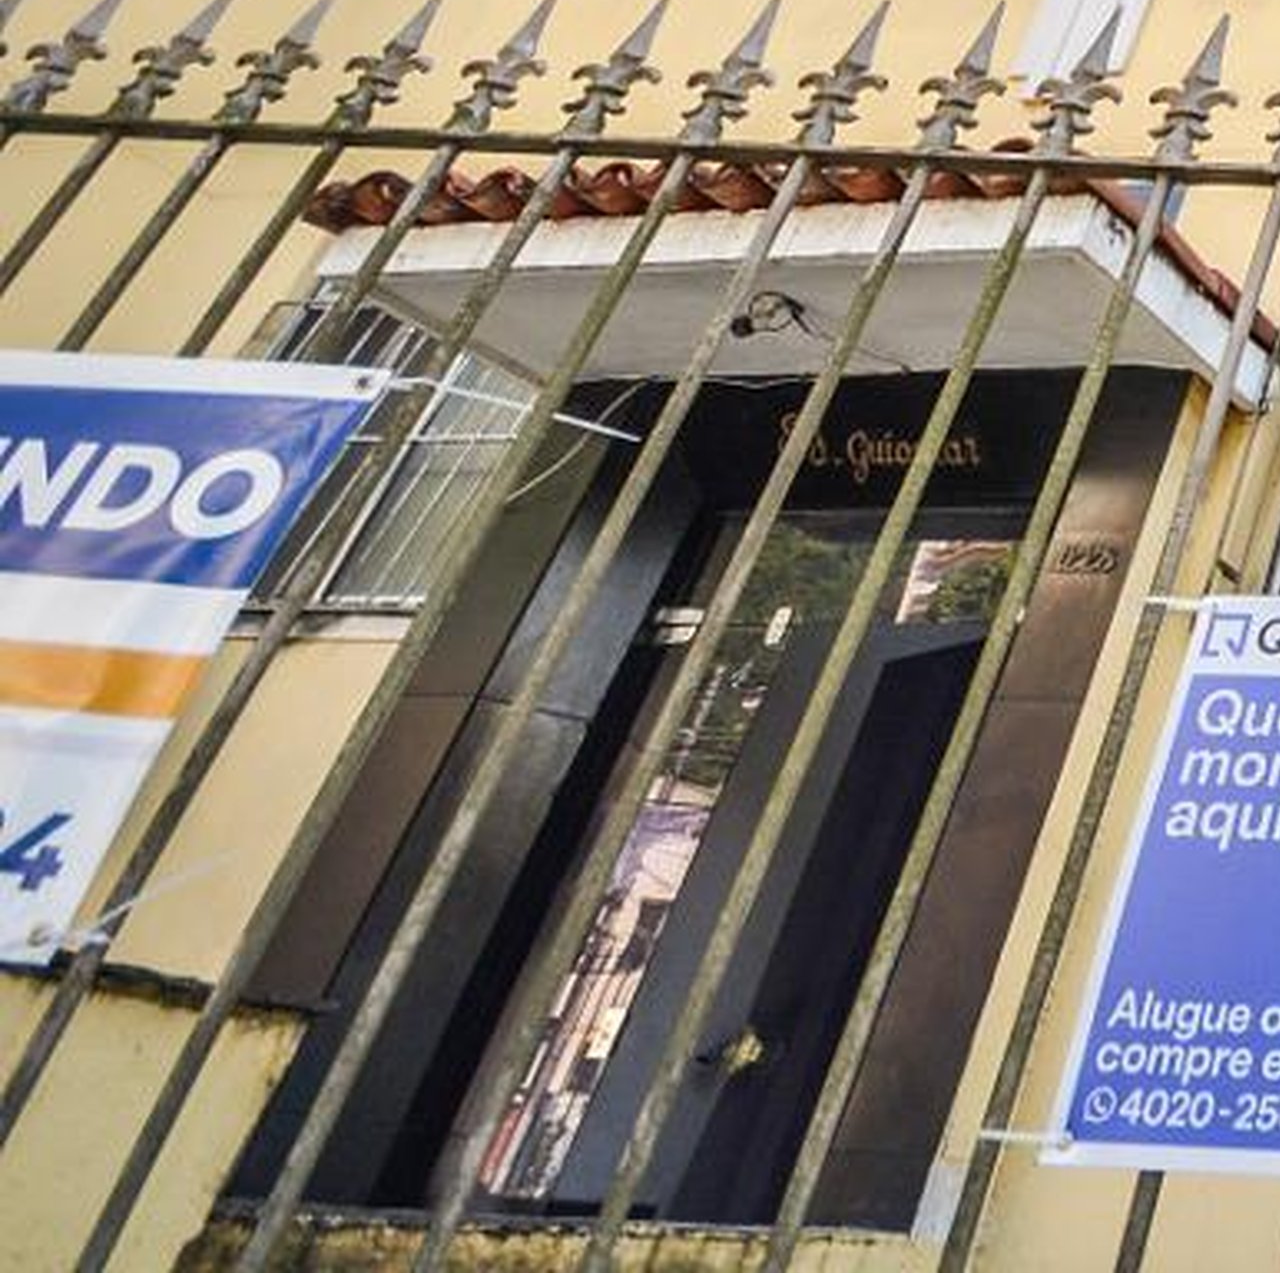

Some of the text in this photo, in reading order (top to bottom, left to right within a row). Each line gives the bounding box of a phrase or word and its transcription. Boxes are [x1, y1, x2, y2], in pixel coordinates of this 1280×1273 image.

[847, 430, 981, 483] Guioar
[0, 438, 284, 540] NDO
[0, 809, 74, 891] 4
[1106, 988, 1252, 1041] Alugue
[1096, 1041, 1254, 1086] compre
